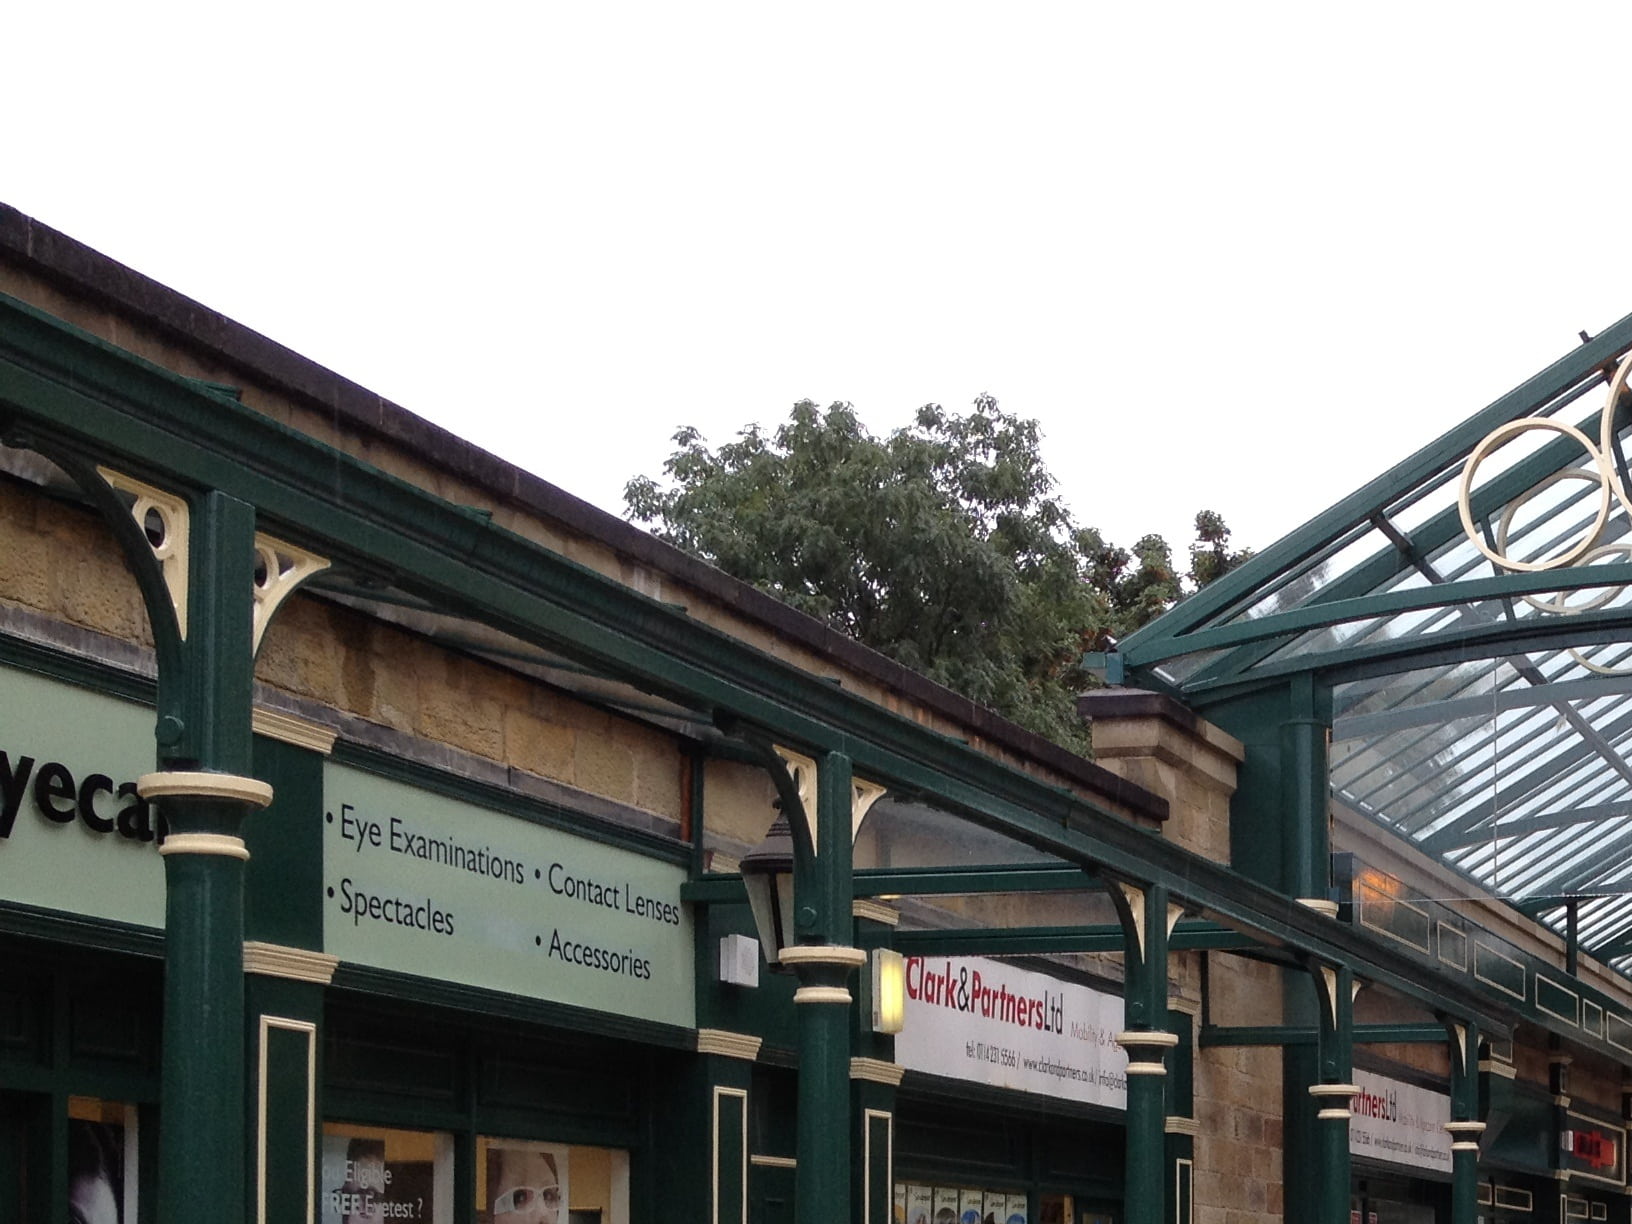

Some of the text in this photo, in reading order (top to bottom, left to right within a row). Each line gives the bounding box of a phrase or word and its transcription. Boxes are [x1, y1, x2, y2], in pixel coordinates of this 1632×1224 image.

[341, 804, 524, 884] Eye Examinations
[340, 878, 454, 936] Spectacles
[549, 863, 680, 926] Contact Lenses
[549, 928, 651, 980] Accessories
[346, 1160, 392, 1189] Eligible
